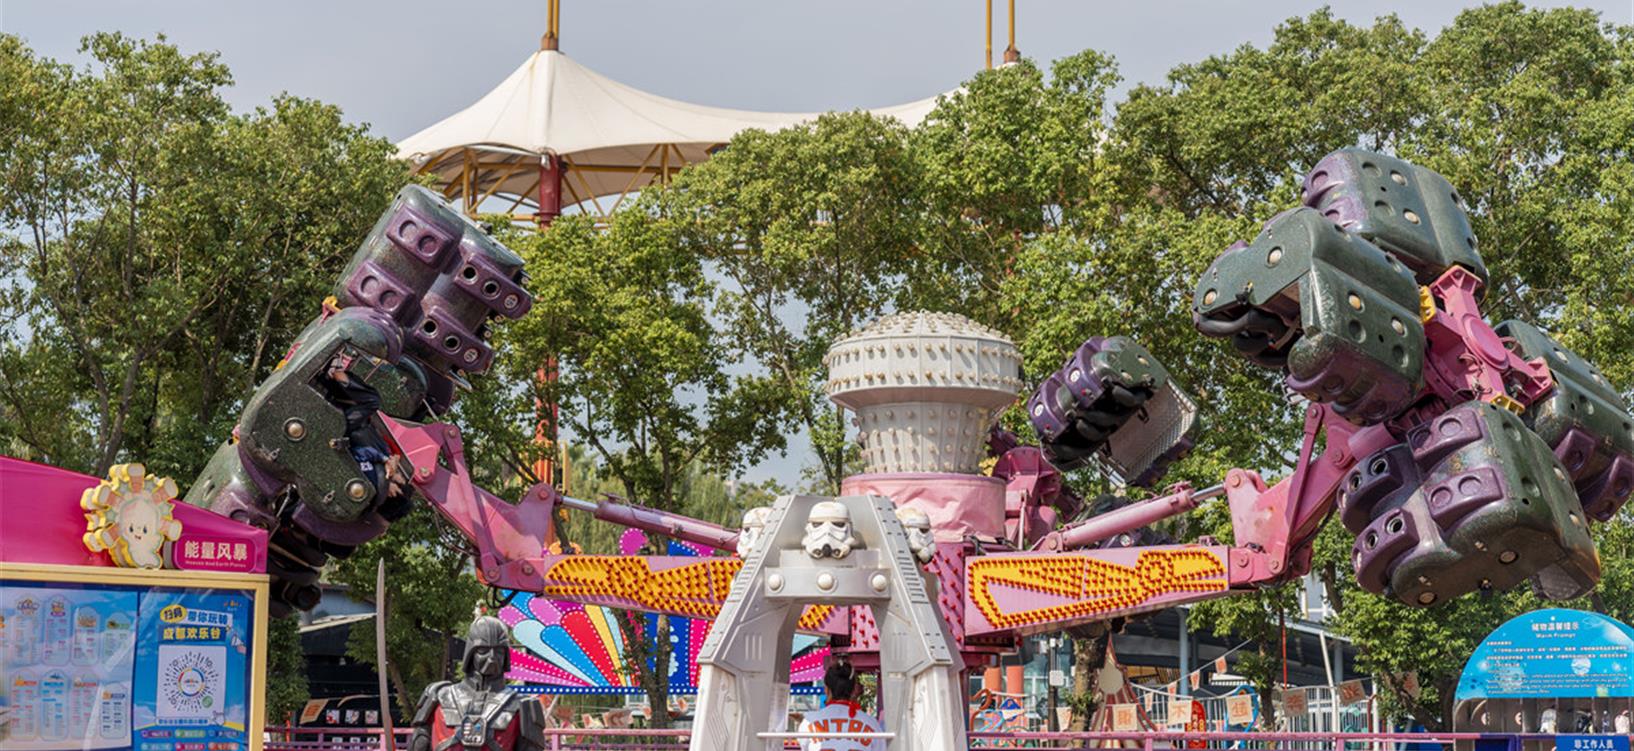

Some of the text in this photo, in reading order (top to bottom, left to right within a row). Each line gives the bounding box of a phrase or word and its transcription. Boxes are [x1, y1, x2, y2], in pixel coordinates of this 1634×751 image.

[185, 541, 247, 560] 能量风暴
[164, 607, 183, 620] 扫码
[188, 611, 227, 624] 带你玩转
[164, 627, 221, 640] 成都欢乐谷
[1574, 739, 1614, 749] 非工作人员
